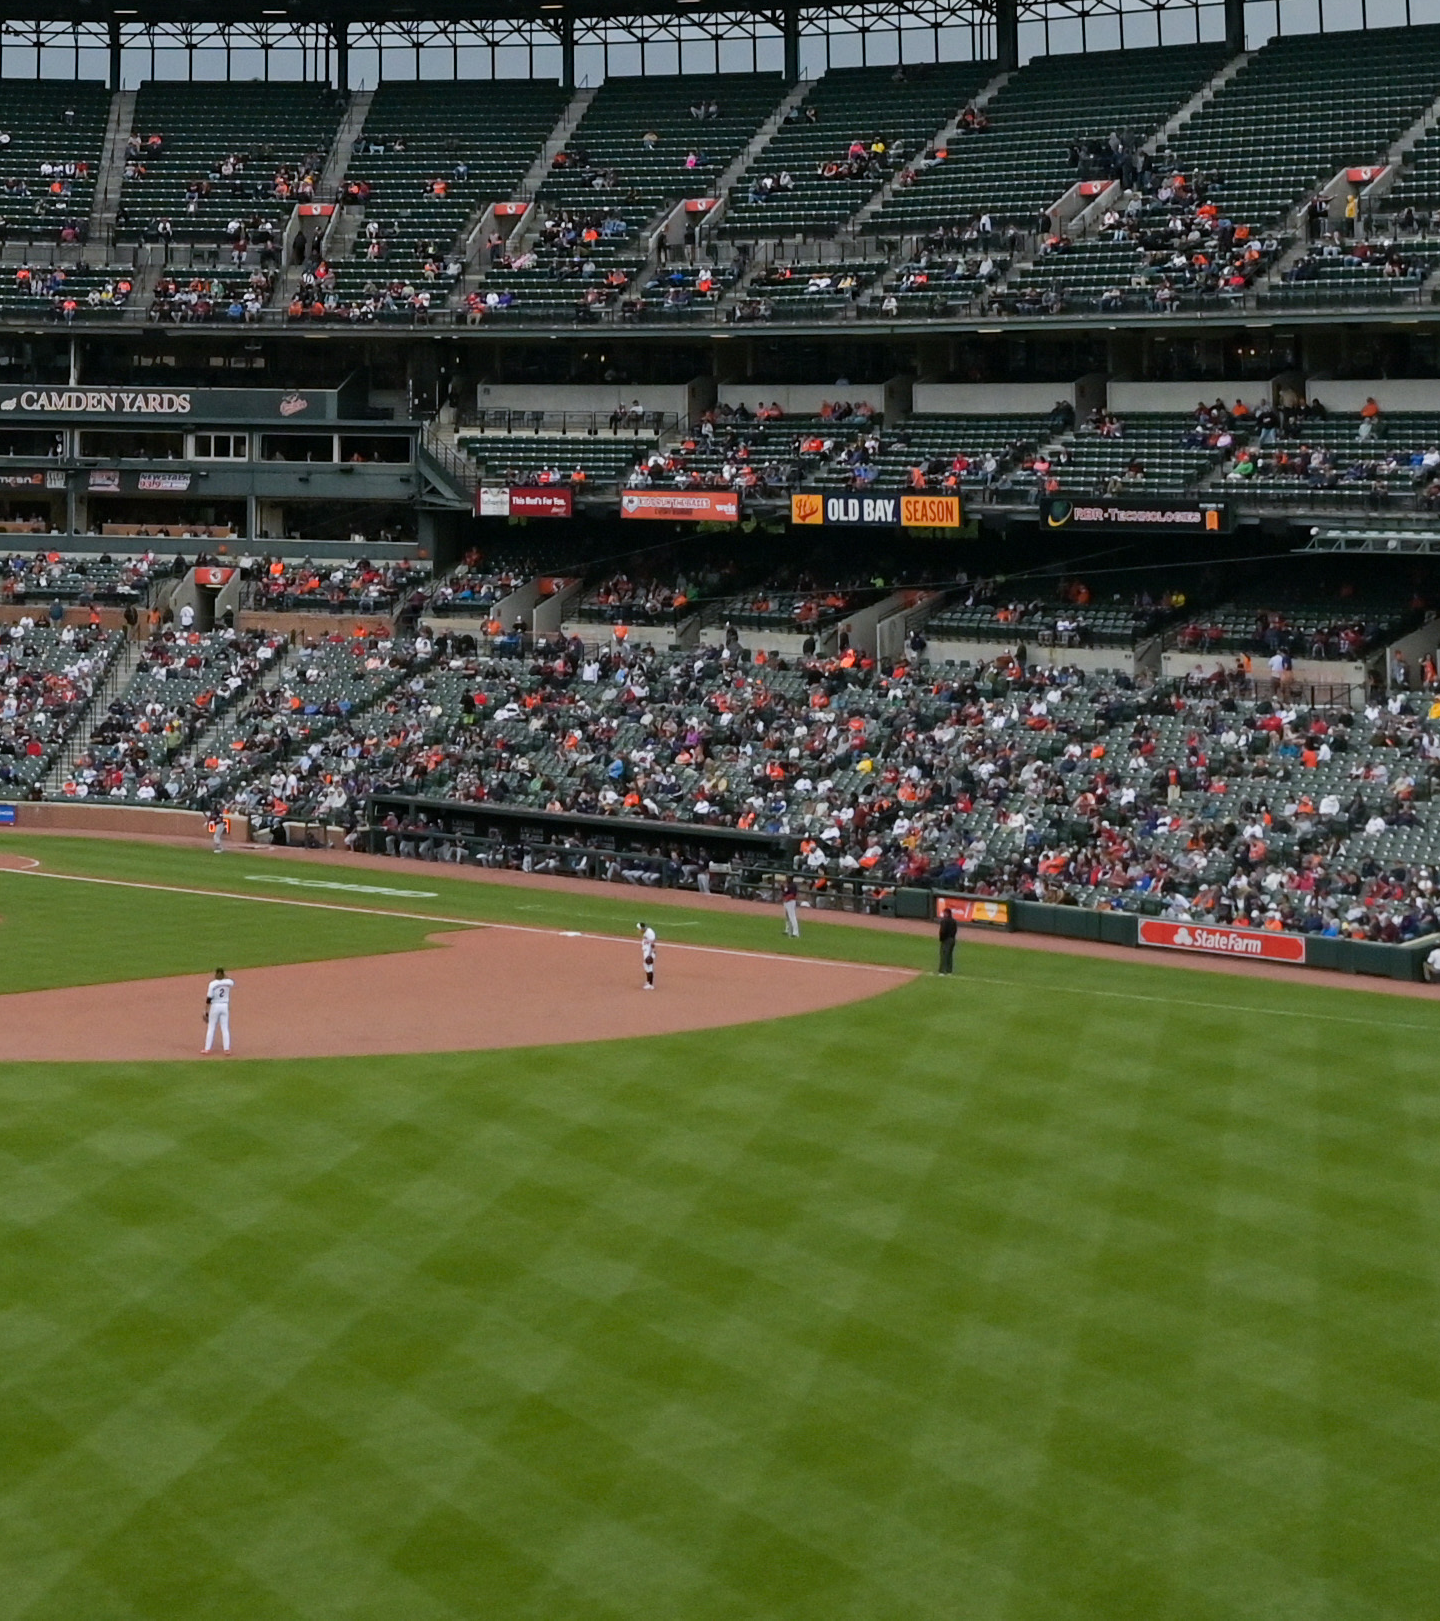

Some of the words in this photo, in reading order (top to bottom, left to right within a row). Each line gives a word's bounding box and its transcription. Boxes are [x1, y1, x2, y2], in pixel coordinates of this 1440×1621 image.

[21, 391, 117, 412] CAMDEN
[118, 393, 191, 413] YARDS
[512, 496, 525, 505] This
[795, 496, 818, 520] It's
[827, 498, 859, 522] OLD
[905, 500, 954, 522] SEASON
[219, 988, 225, 998] 2
